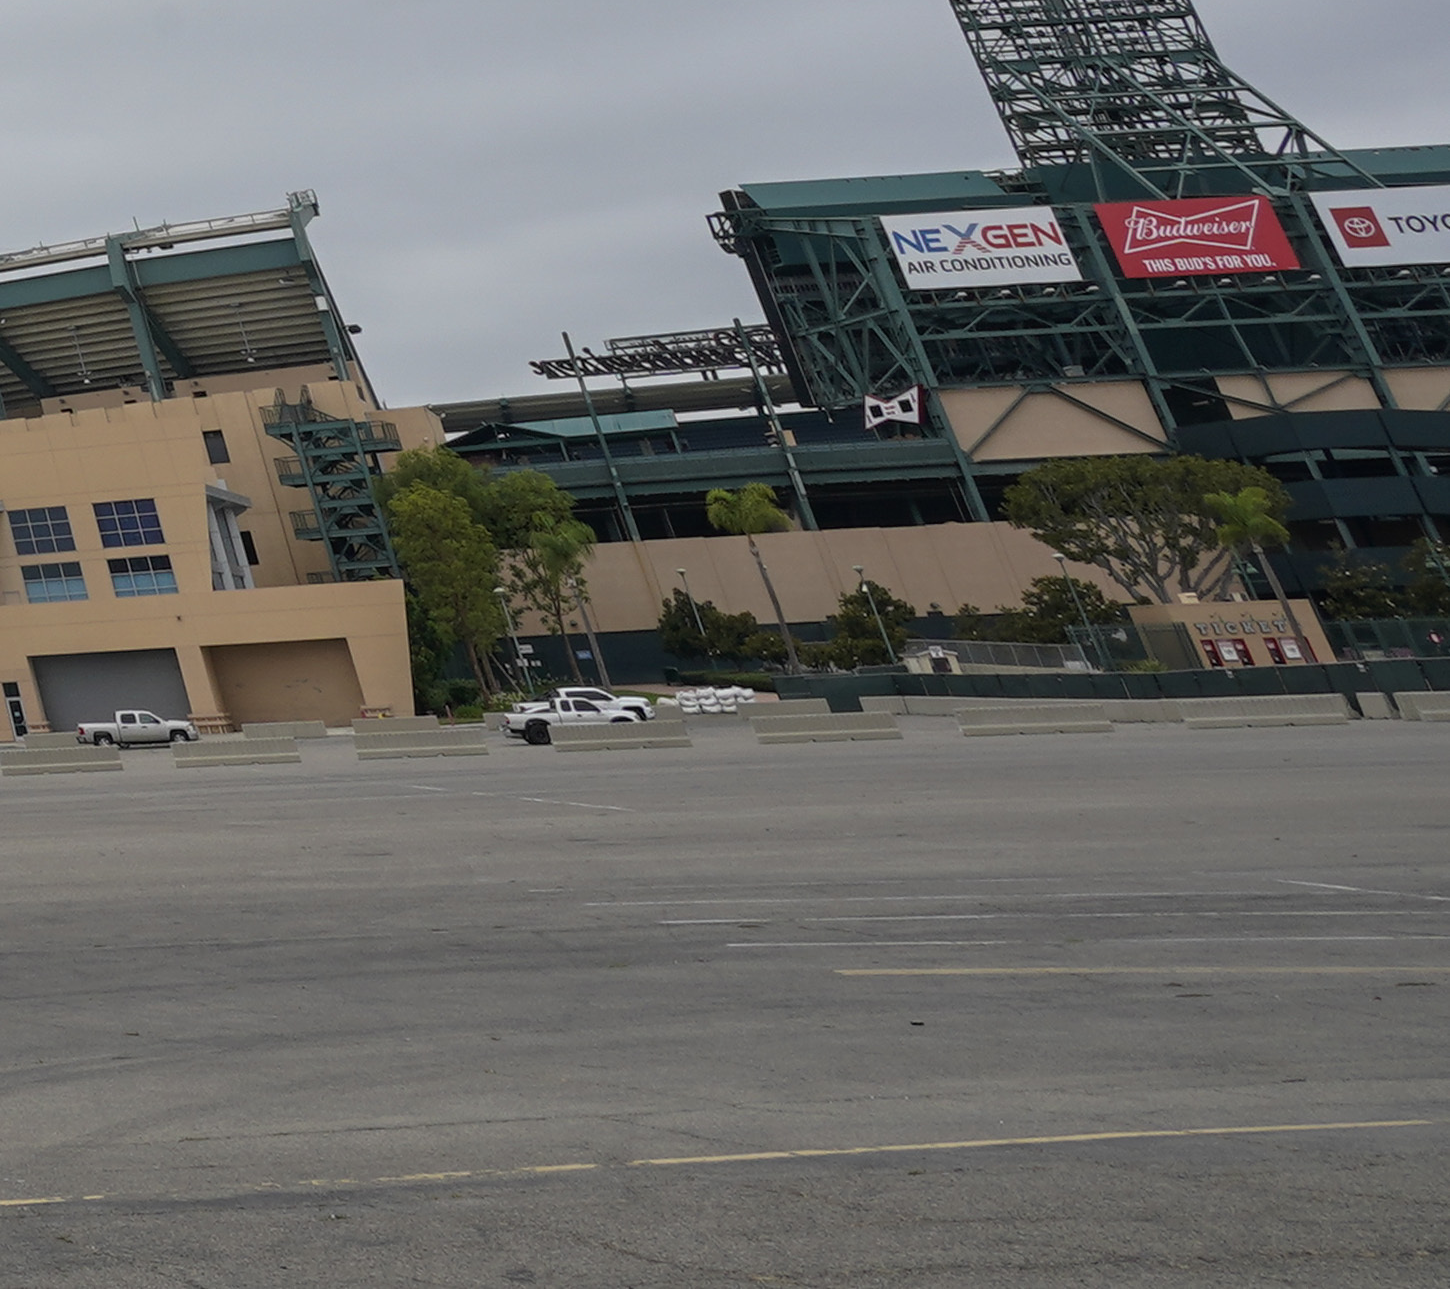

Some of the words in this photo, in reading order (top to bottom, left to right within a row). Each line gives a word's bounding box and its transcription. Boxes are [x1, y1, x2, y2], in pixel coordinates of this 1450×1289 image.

[892, 221, 1064, 256] NEXGEN
[1125, 216, 1255, 241] Budweiser
[907, 258, 938, 275] AIR
[940, 252, 1073, 273] CONDITIONING
[1142, 258, 1174, 273] THIS
[1174, 256, 1216, 272] BUD'S
[1216, 254, 1244, 269] FOR
[1243, 253, 1277, 268] YOU.
[1193, 619, 1303, 636] TICKET
